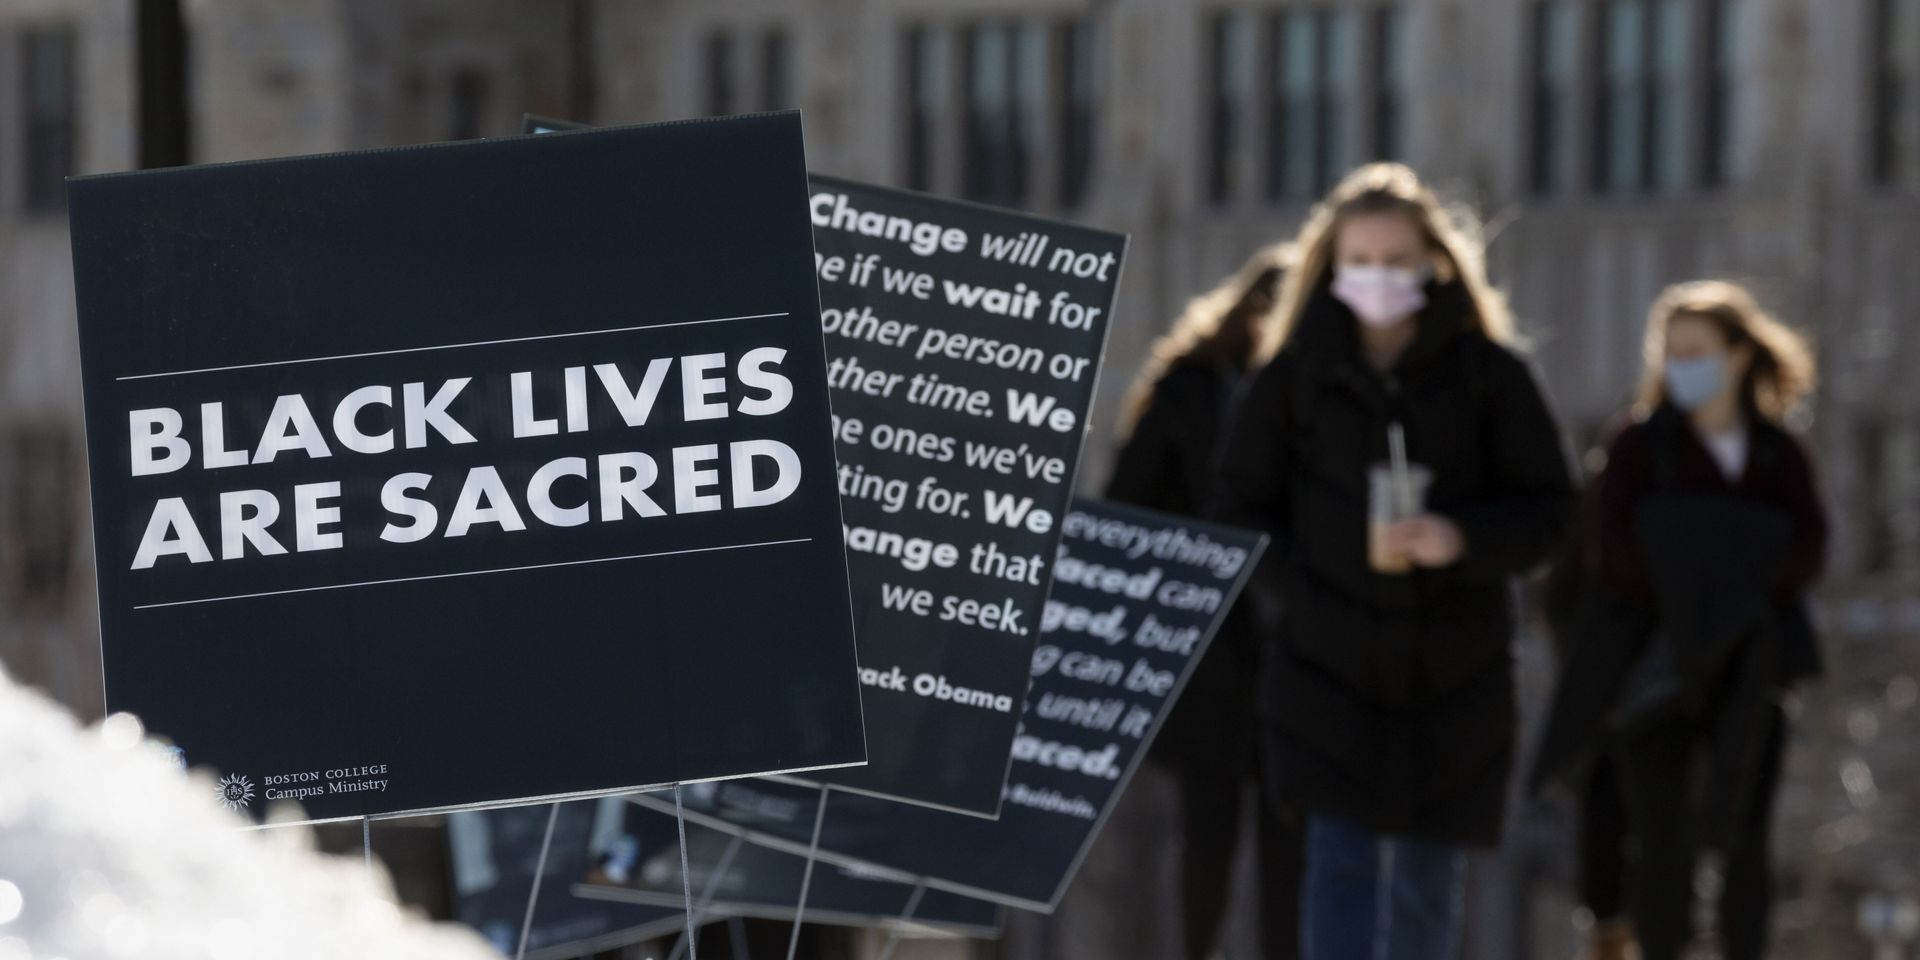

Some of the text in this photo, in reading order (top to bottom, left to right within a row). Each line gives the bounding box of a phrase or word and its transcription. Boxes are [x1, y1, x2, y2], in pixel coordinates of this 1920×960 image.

[809, 193, 1116, 281] Change will not
[849, 253, 881, 287] if
[882, 266, 935, 299] we
[943, 279, 1041, 320] wait
[1048, 291, 1101, 331] for
[822, 306, 1090, 382] other person or
[129, 347, 794, 476] BLACK LIVES
[906, 373, 994, 418] time.
[1005, 388, 1076, 432] We
[870, 424, 956, 462] ones
[964, 440, 1066, 484] we've
[131, 439, 802, 570] ARE SACRED
[836, 460, 1053, 534] ting for. We
[843, 523, 1045, 586] ange that
[1062, 511, 1246, 580] everything
[1054, 543, 1223, 615] aced can
[881, 582, 1028, 637] we seek.
[1133, 614, 1201, 656] but
[912, 673, 1013, 713] Obama
[1058, 651, 1125, 686] can
[1124, 658, 1175, 696] be
[1036, 691, 1126, 731] until
[1118, 704, 1152, 739] it
[264, 764, 388, 786] BOSTON COLLEGE
[1012, 735, 1121, 780] aced.
[265, 779, 388, 801] Campus Ministry
